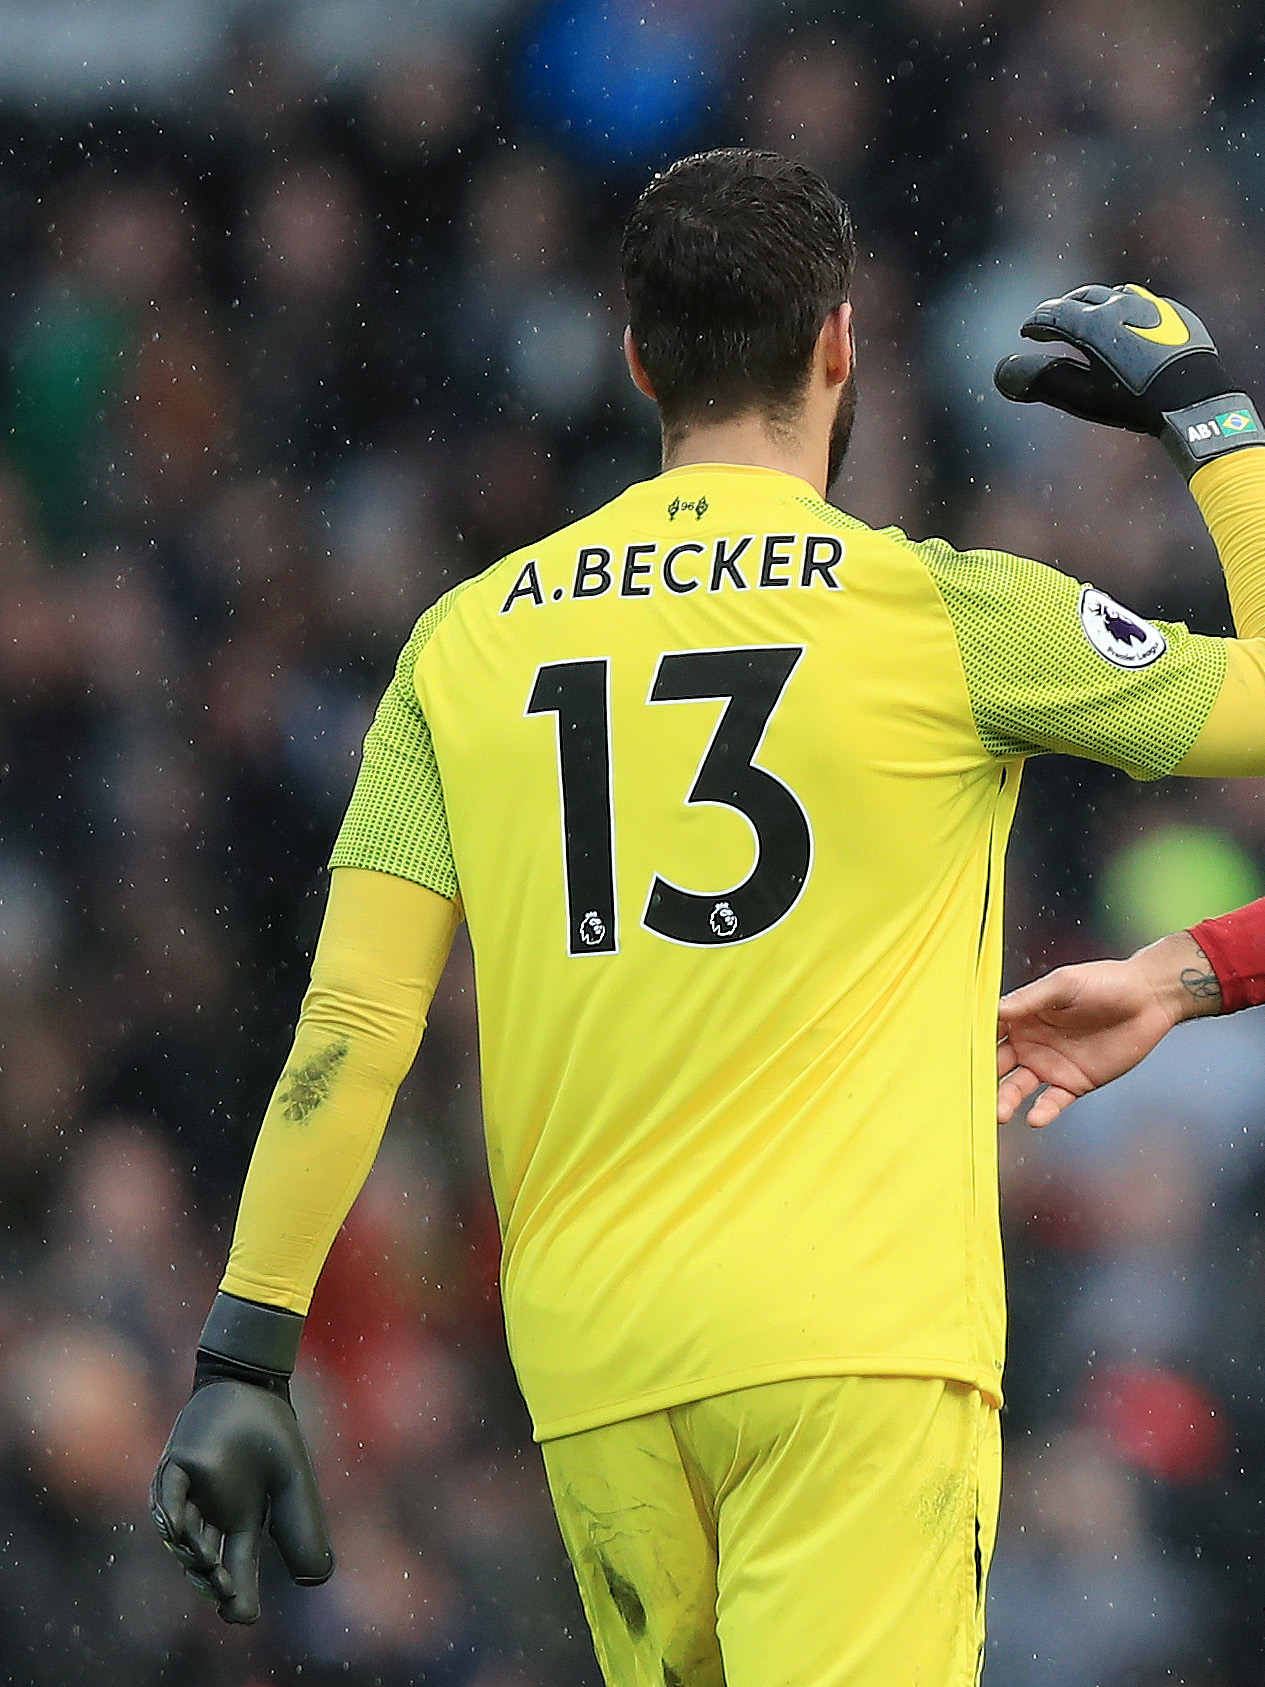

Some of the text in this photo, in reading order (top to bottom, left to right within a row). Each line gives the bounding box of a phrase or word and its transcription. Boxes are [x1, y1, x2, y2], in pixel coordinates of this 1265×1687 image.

[1187, 420, 1221, 443] AB1
[681, 501, 696, 511] 96
[500, 534, 845, 615] A.BECKER
[525, 644, 815, 956] 13
